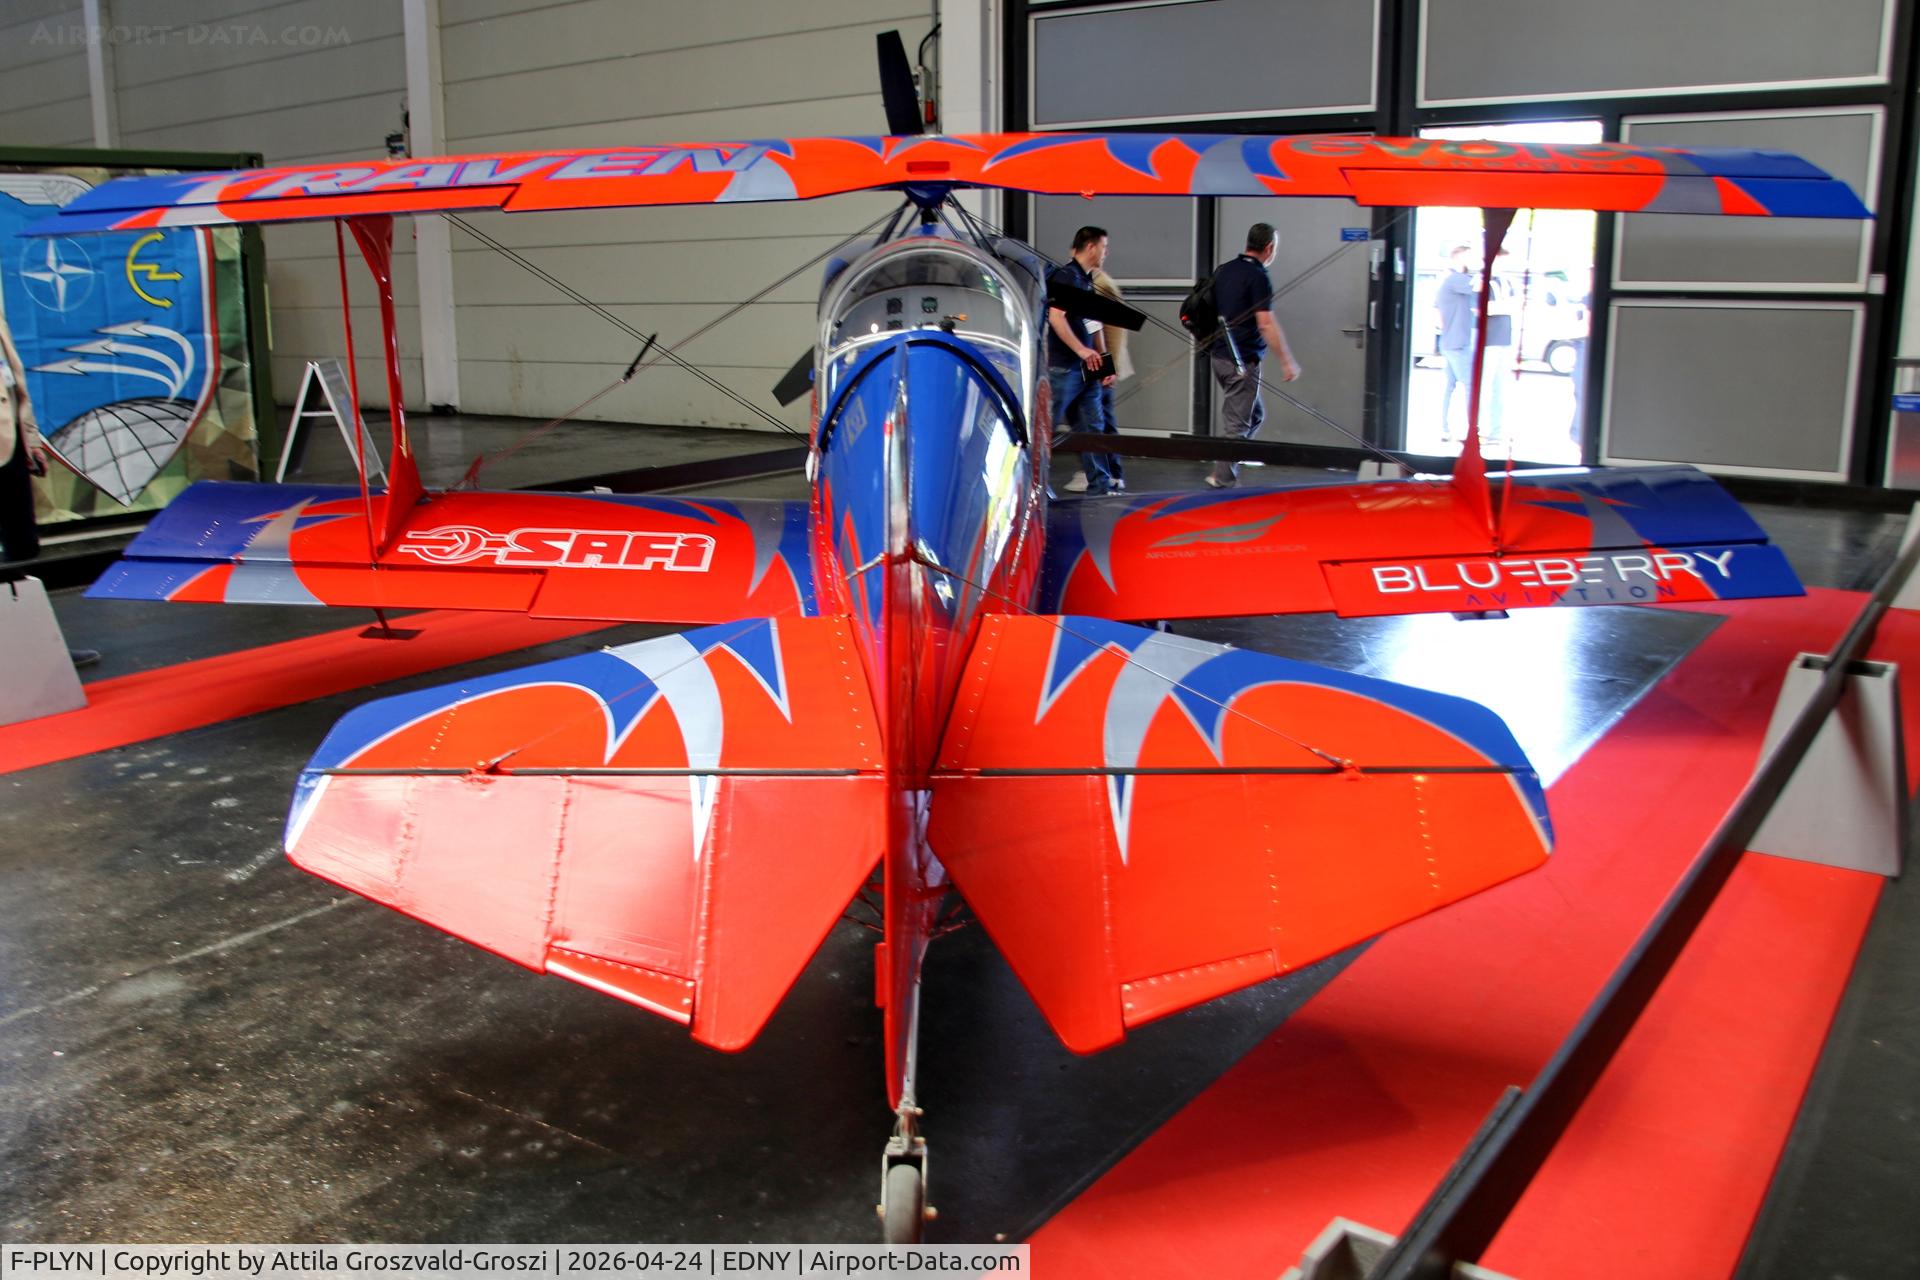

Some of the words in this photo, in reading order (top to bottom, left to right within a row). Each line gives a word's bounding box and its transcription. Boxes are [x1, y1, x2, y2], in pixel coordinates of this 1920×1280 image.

[243, 146, 771, 200] RAVEN
[1371, 549, 1734, 594] BLUEBERRY
[1465, 583, 1676, 607] AVIATION
